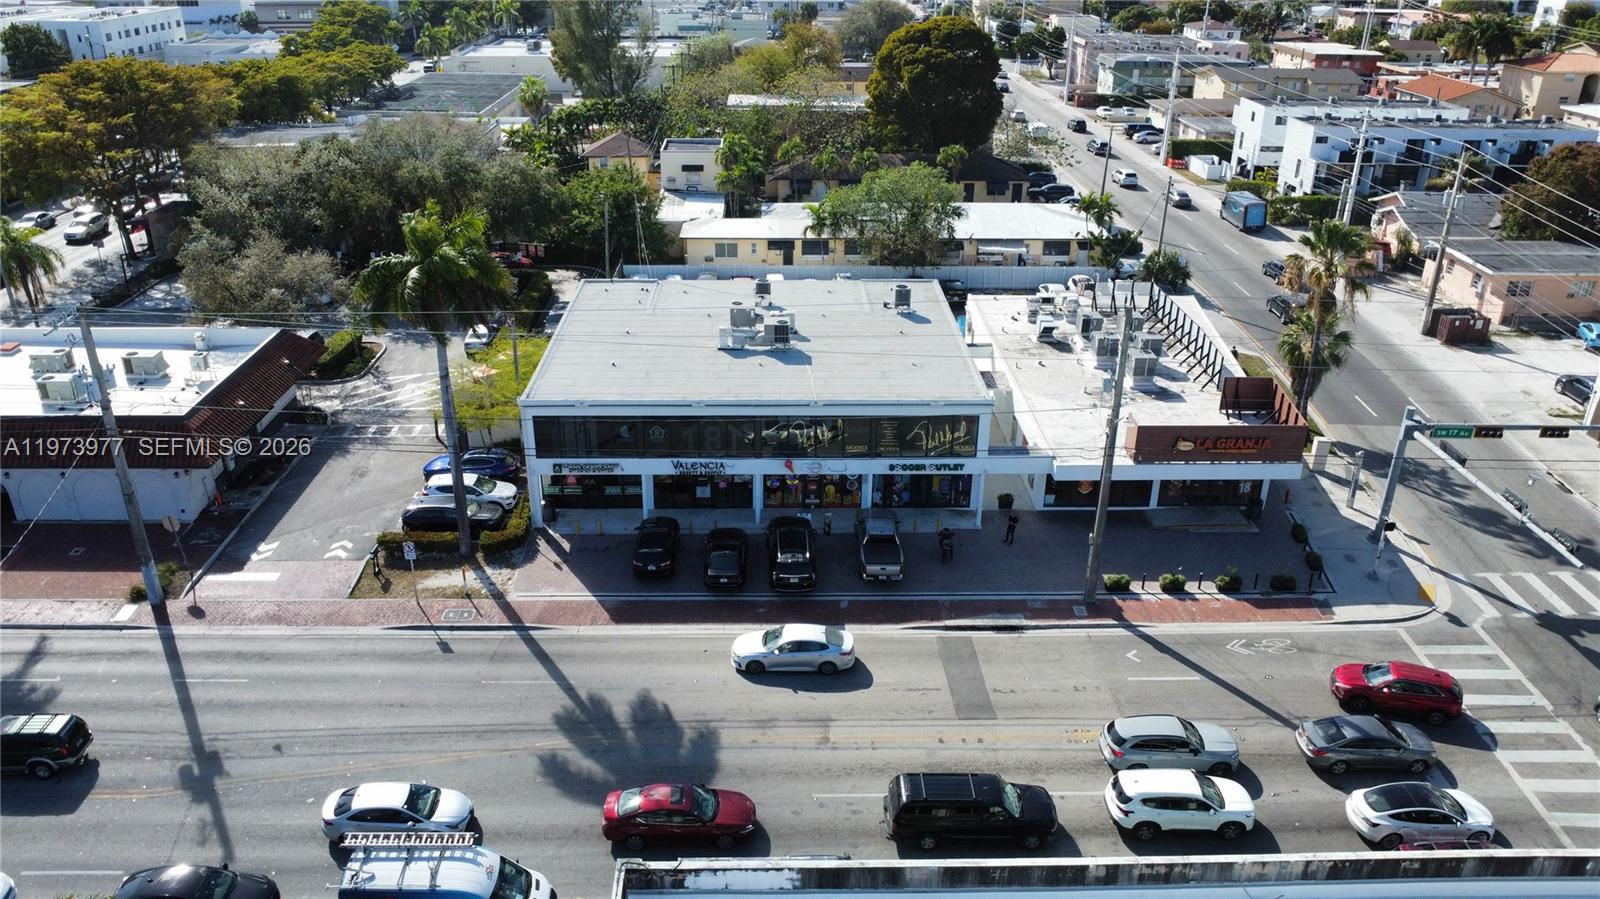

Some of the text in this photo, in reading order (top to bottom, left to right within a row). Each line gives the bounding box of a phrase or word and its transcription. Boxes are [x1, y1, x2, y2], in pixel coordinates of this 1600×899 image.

[1195, 438, 1213, 448] LA
[1217, 438, 1272, 448] GRANJA
[1239, 482, 1252, 493] 18
